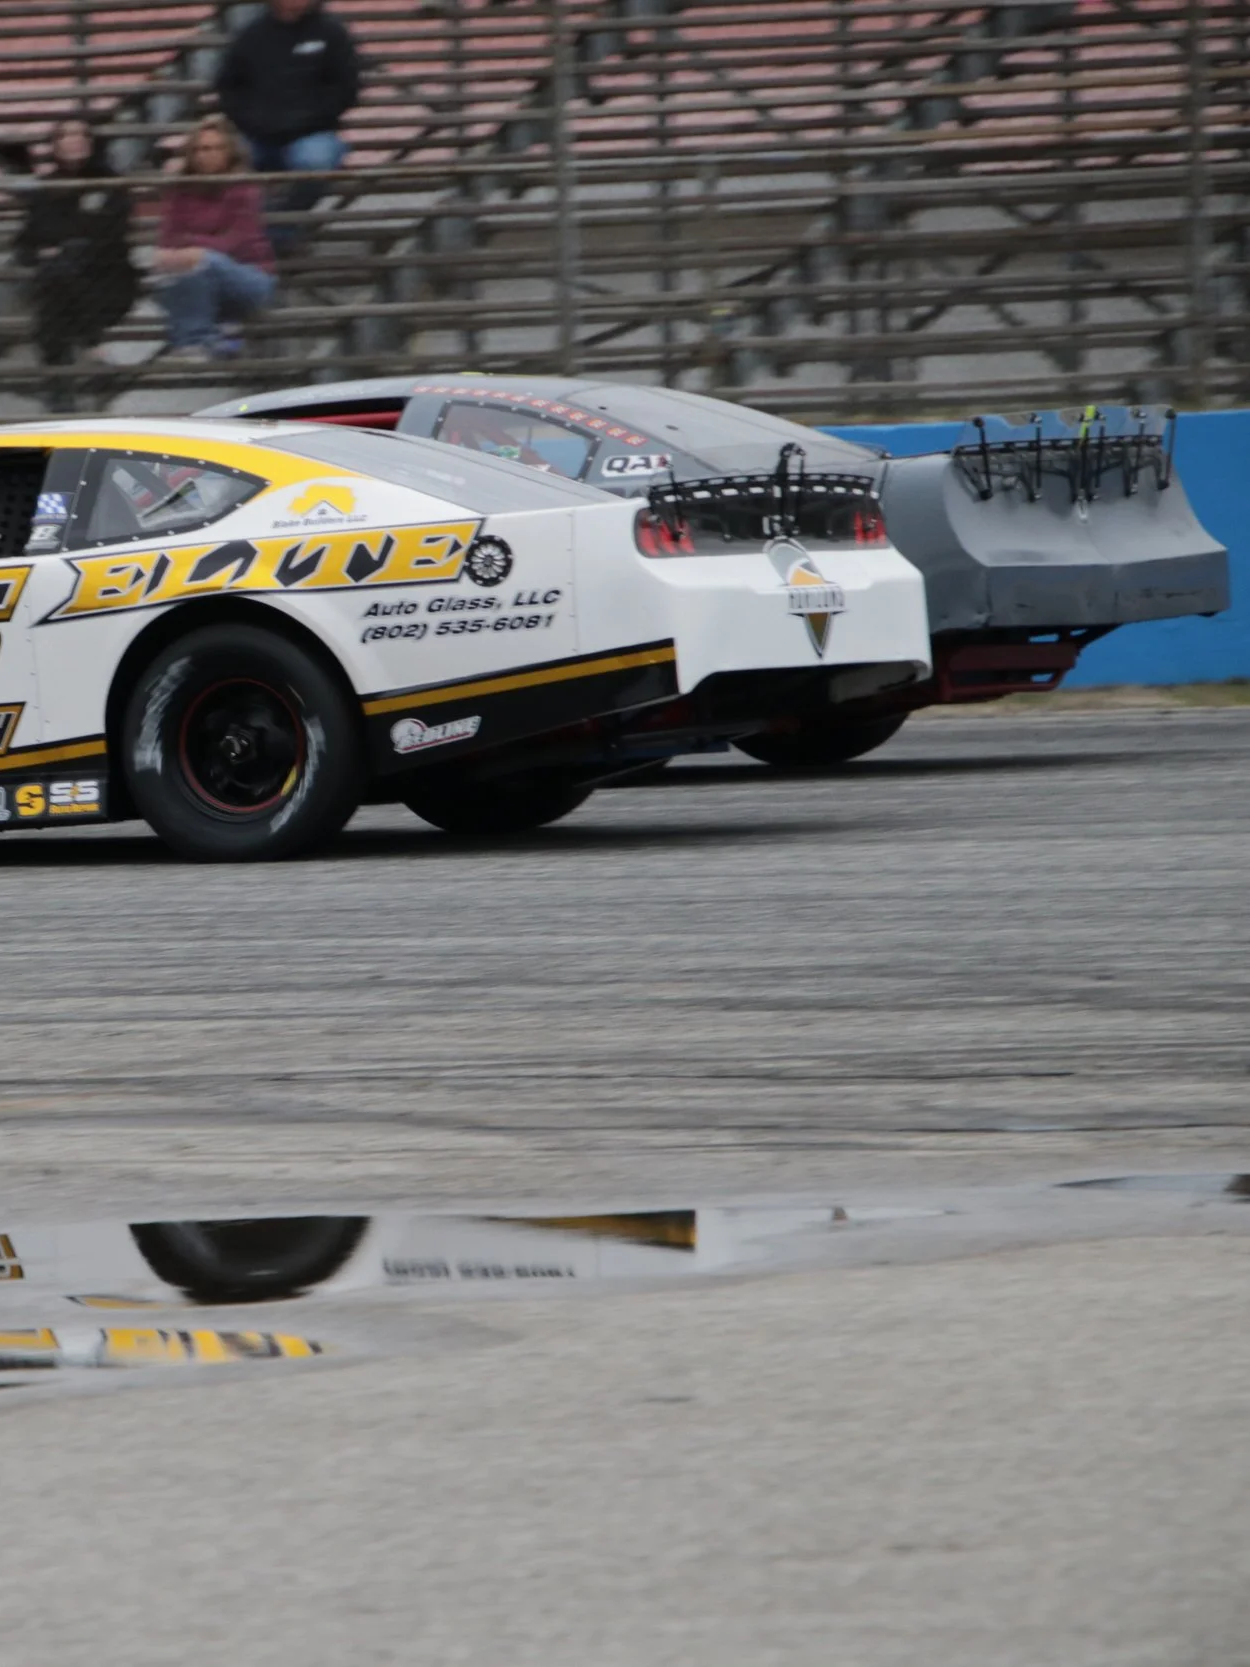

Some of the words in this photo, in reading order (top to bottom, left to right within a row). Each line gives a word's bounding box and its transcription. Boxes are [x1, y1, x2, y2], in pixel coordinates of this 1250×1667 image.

[364, 602, 418, 617] Auto
[512, 589, 562, 606] LLC
[360, 622, 428, 643] (802)
[435, 614, 556, 636] 535-6081
